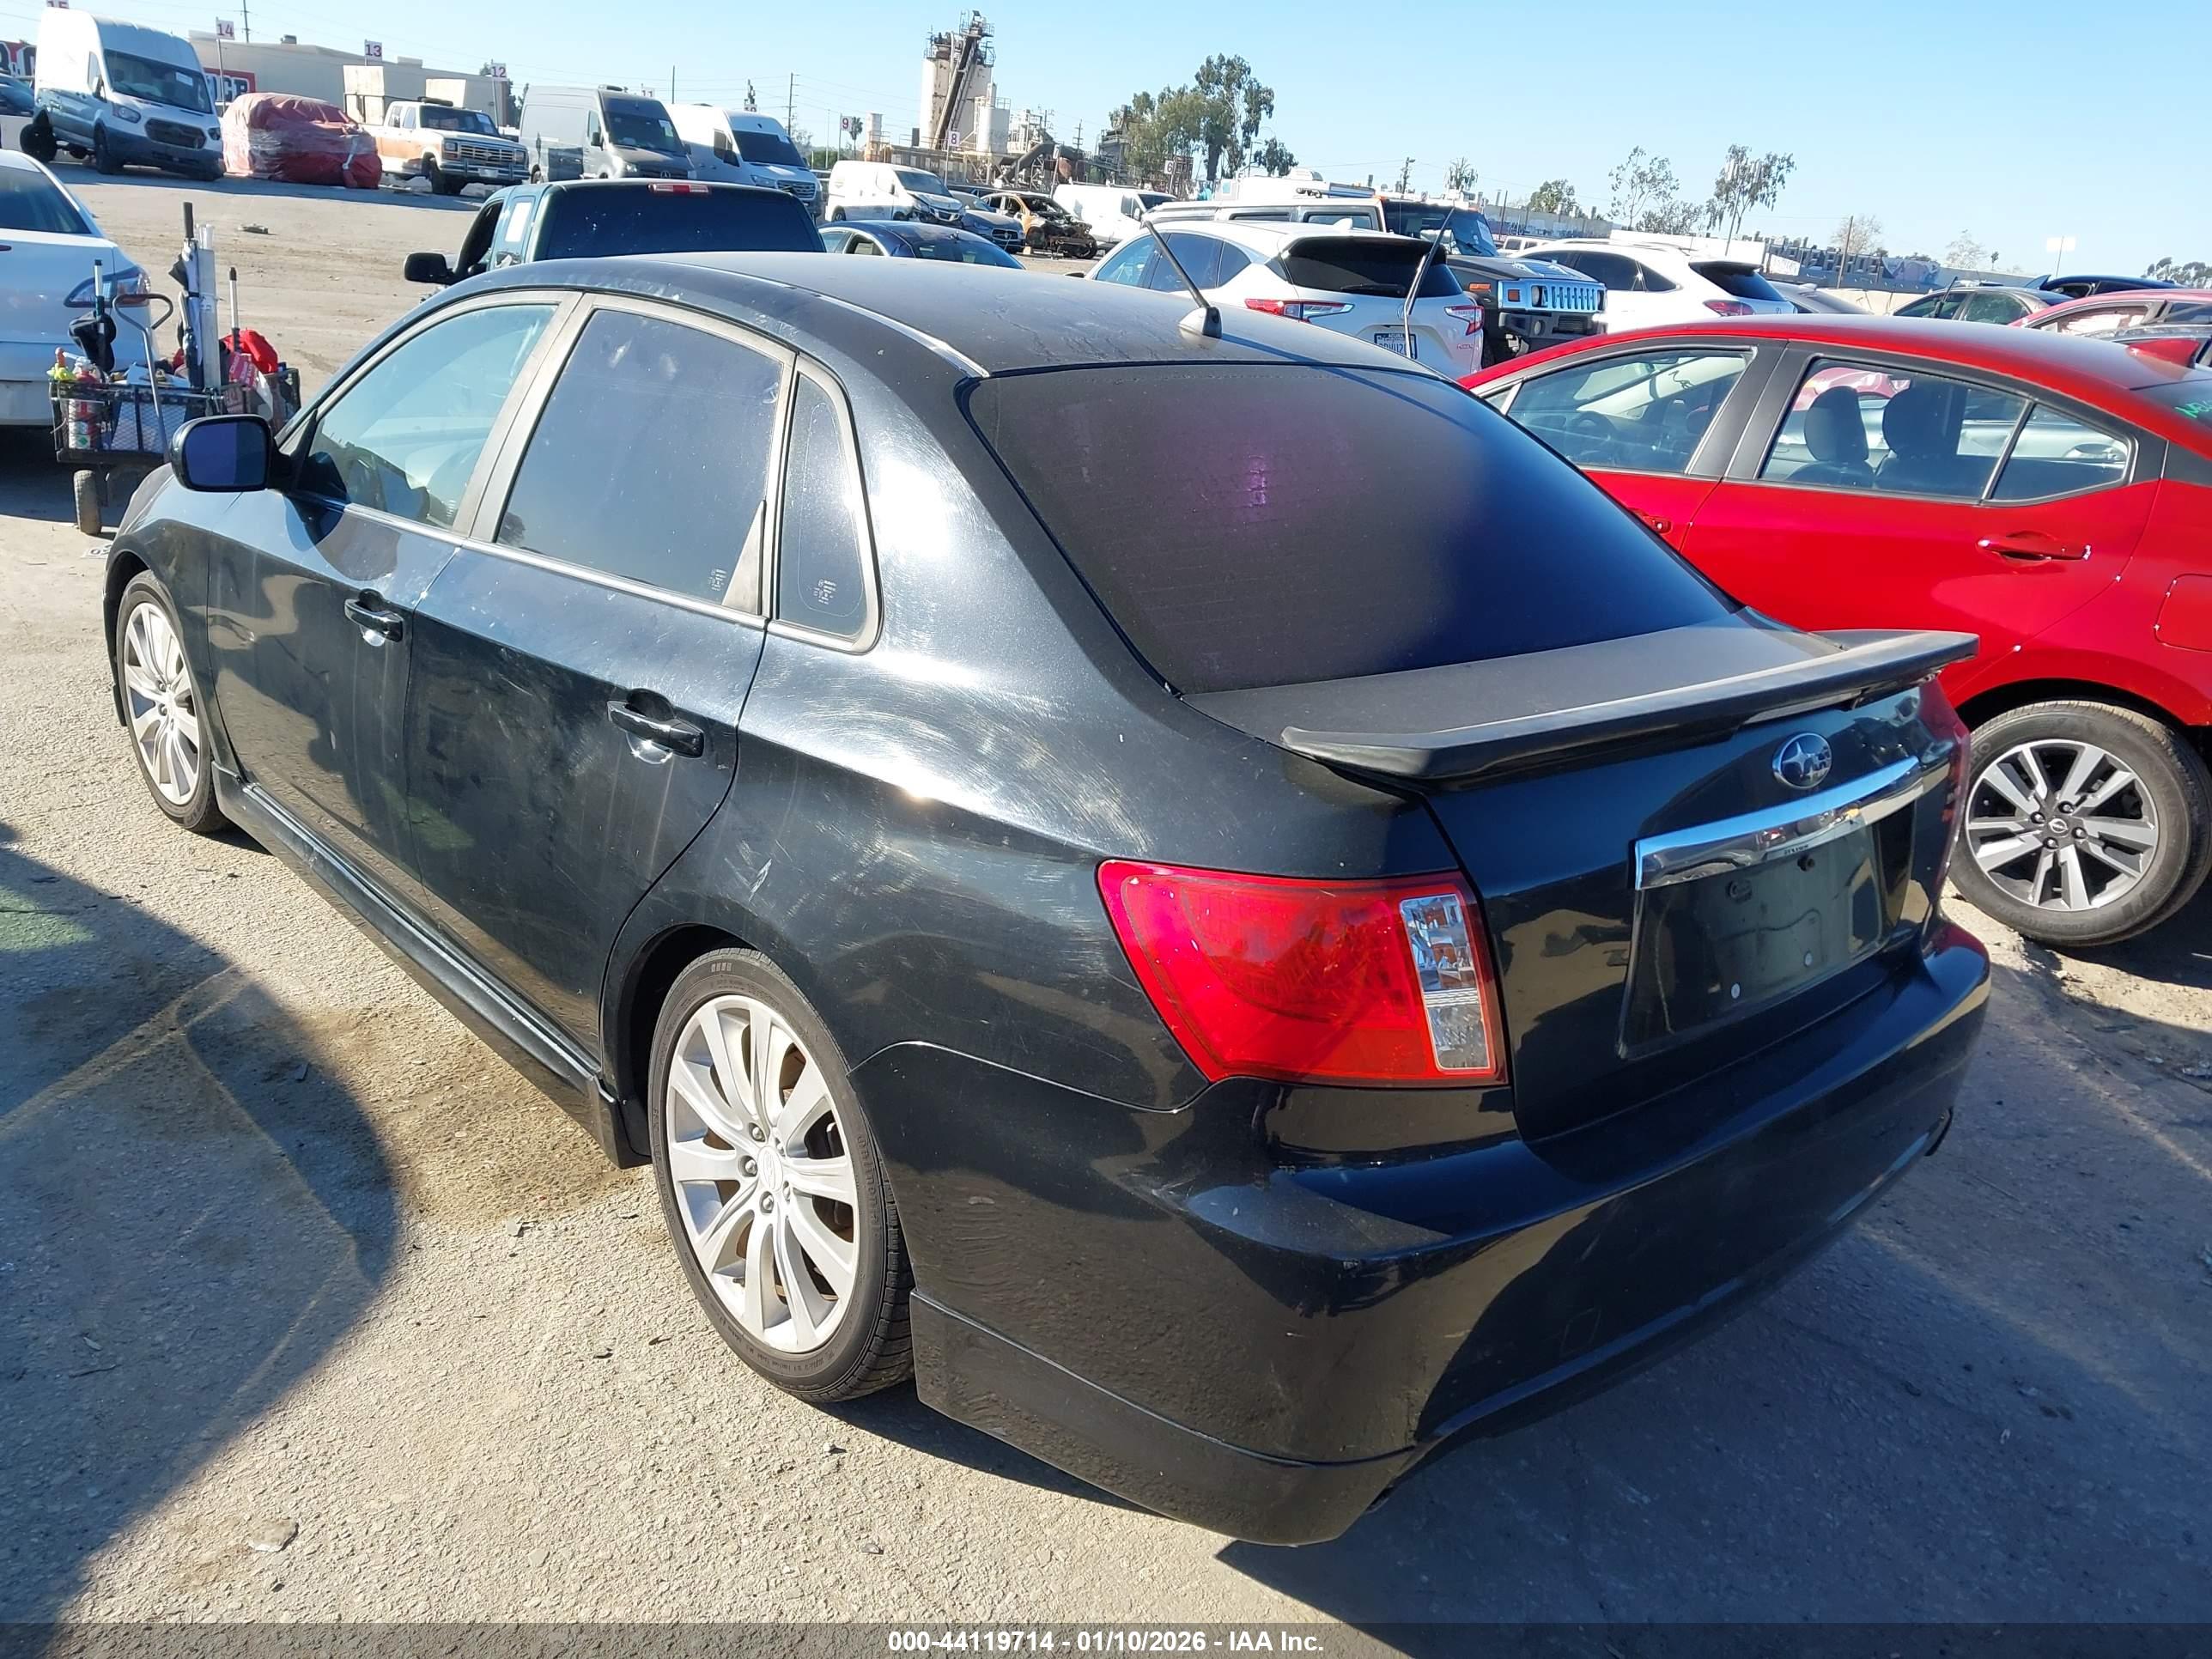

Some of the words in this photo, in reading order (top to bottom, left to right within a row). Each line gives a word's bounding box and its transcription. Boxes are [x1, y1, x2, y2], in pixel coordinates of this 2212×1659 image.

[217, 23, 234, 37] 14
[365, 44, 382, 57] 13
[492, 66, 507, 77] 12
[842, 117, 849, 130] 9
[951, 133, 957, 144] 8
[1168, 161, 1173, 172] 6
